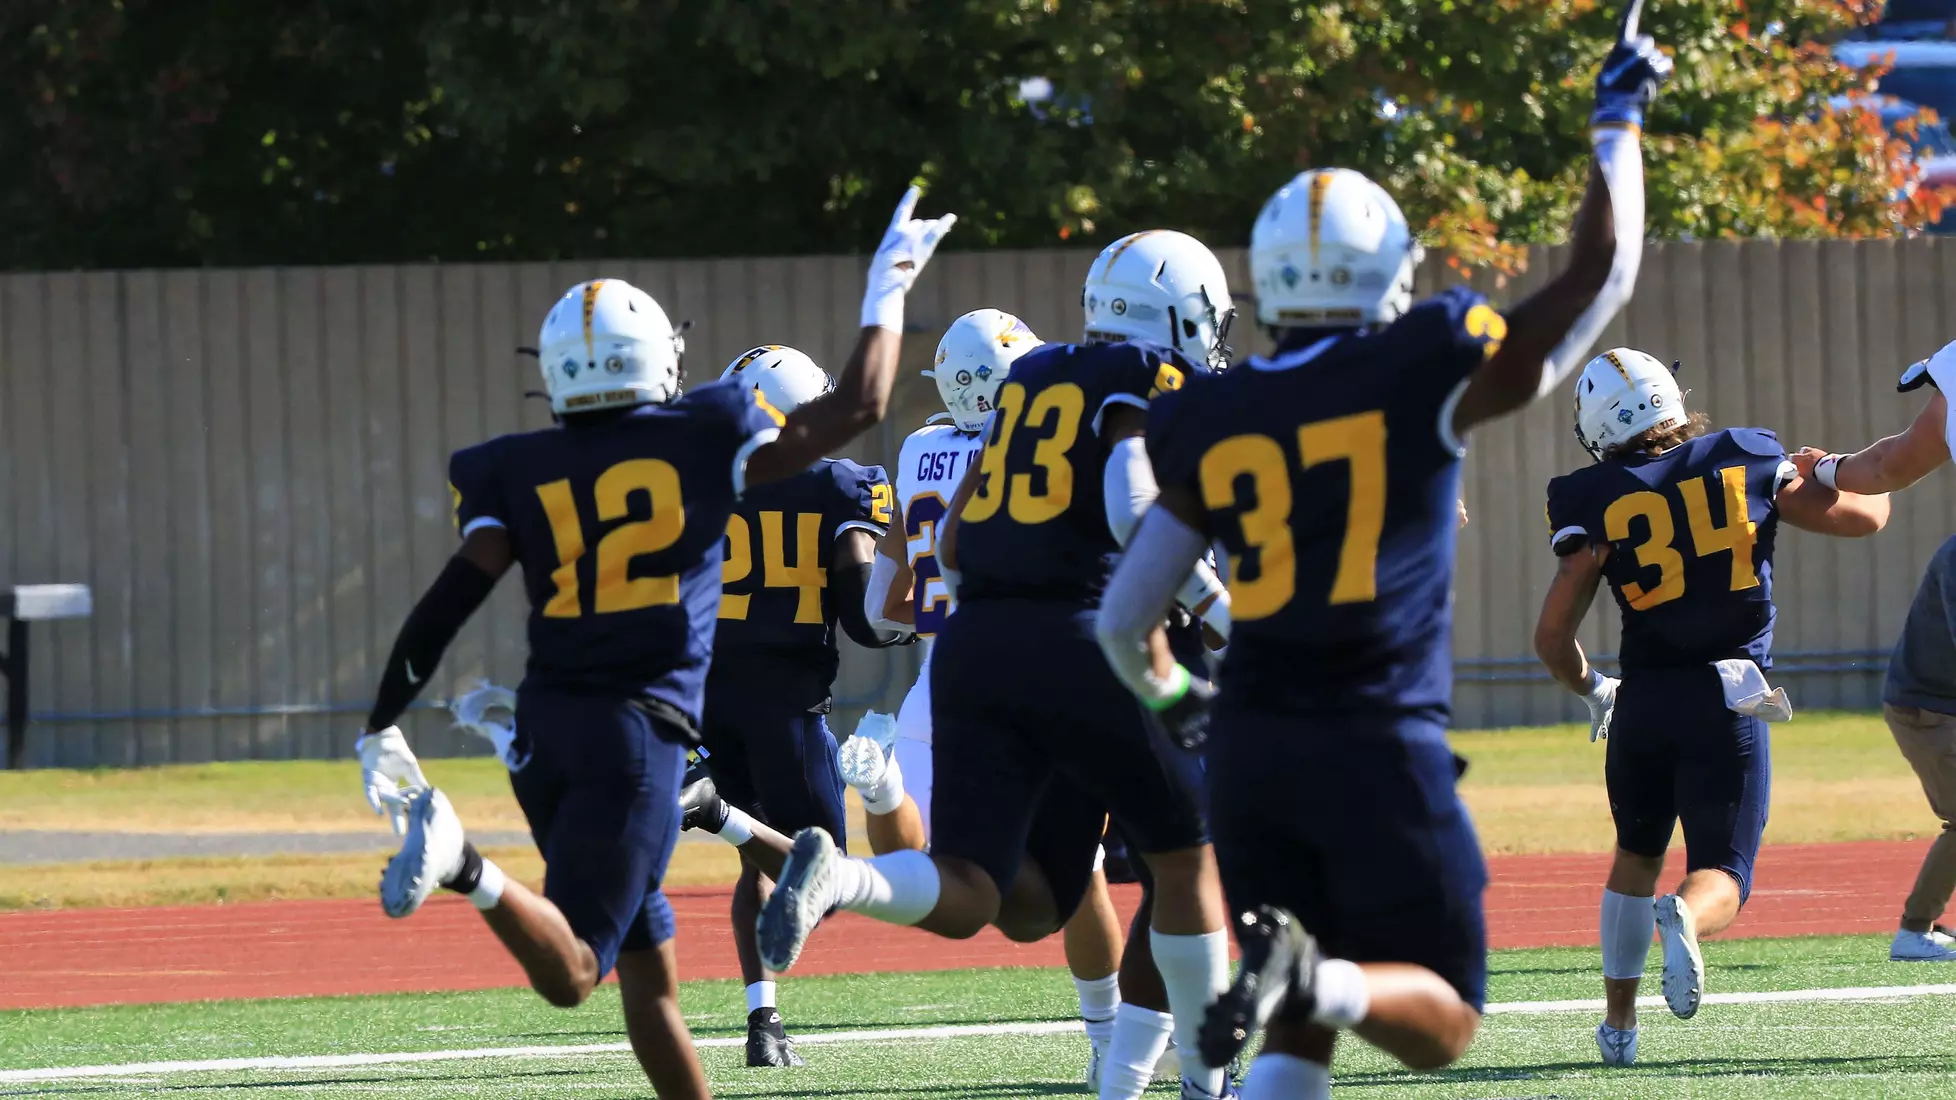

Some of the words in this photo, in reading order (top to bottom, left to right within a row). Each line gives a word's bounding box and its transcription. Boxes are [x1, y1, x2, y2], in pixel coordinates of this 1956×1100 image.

[917, 451, 960, 481] GIST
[960, 382, 1085, 525] 93
[1200, 411, 1387, 621] 37
[535, 458, 686, 618] 12
[716, 511, 828, 624] 24
[1603, 465, 1760, 611] 34
